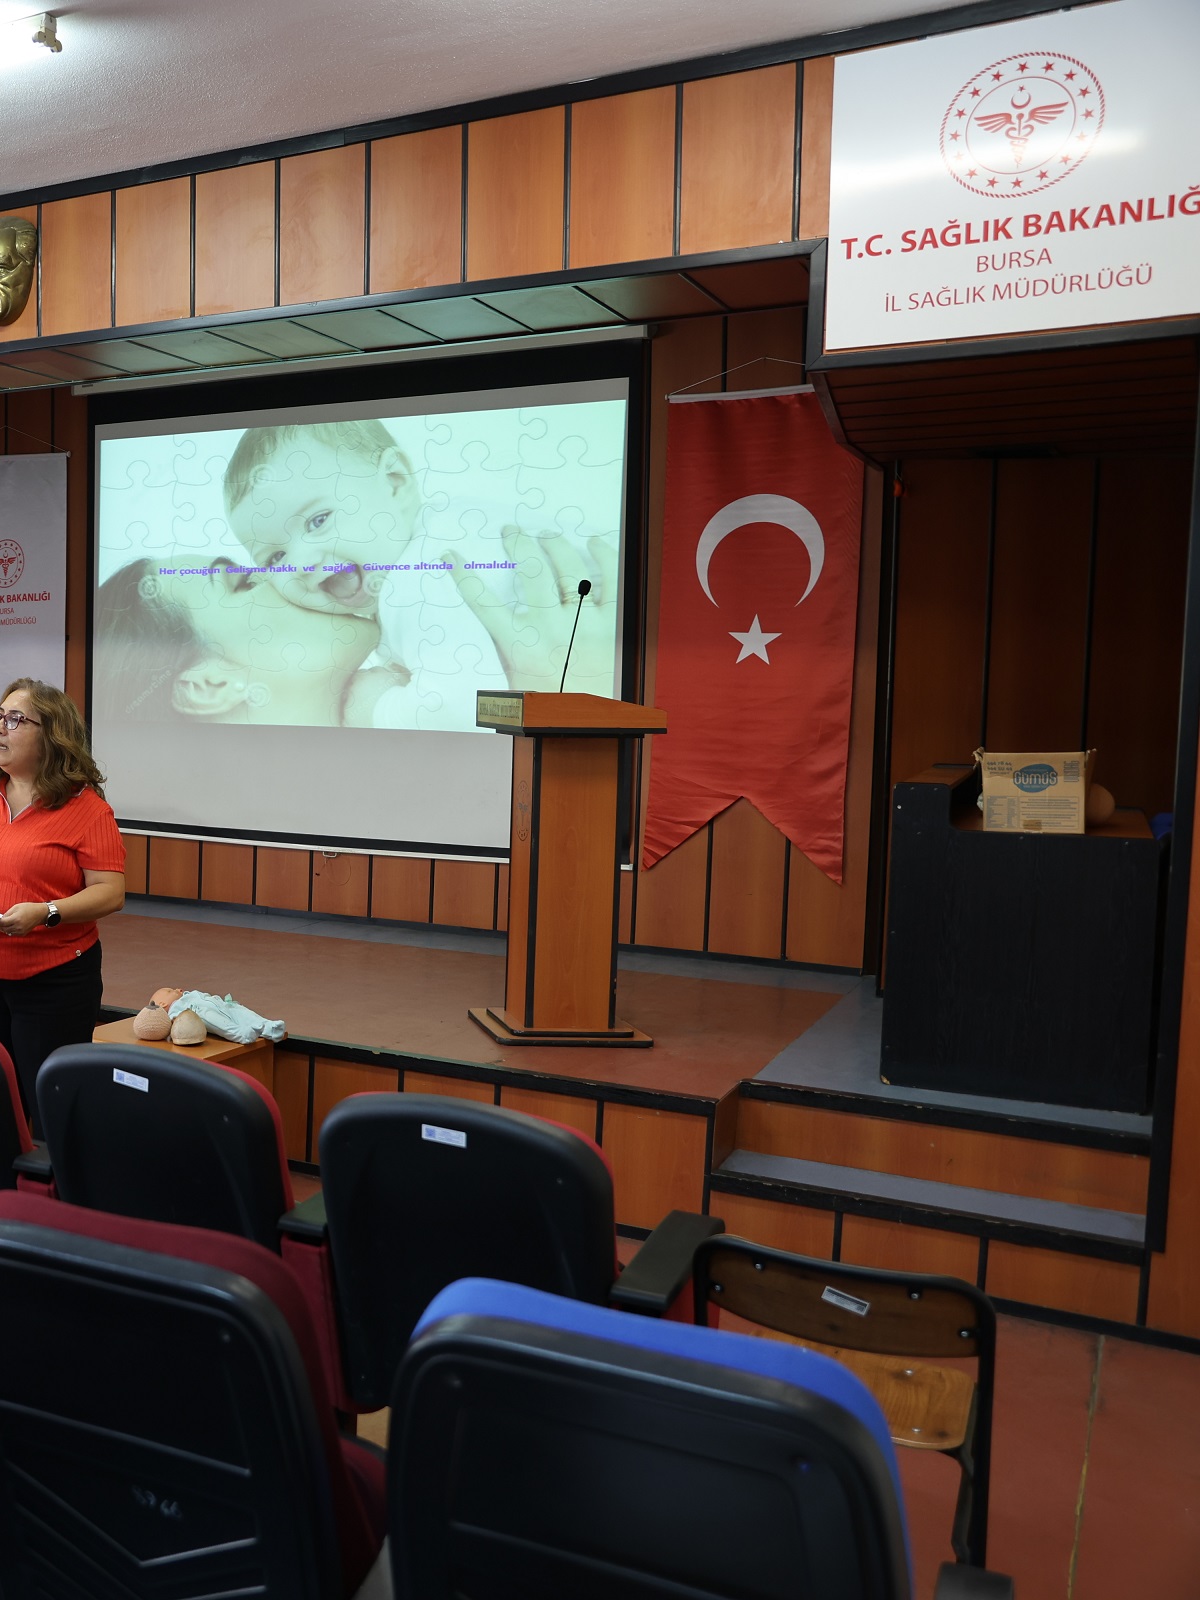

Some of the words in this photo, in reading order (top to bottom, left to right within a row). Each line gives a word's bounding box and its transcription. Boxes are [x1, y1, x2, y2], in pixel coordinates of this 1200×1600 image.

[841, 234, 892, 260] T.C.
[900, 217, 1013, 253] SAĞLIK
[1022, 185, 1200, 238] BAKANLIĞ
[976, 248, 1052, 273] BURSA
[885, 292, 902, 312] İL
[907, 286, 986, 310] SAĞLIK
[991, 262, 1153, 301] MÜDÜRLÜĞÜ
[159, 567, 177, 576] Her
[179, 566, 221, 578] çocuğun
[226, 565, 267, 577] Gelişme
[269, 564, 297, 574] hakkı
[363, 562, 411, 572] Güvence
[414, 561, 453, 571] altında
[464, 560, 517, 571] olmalıdır
[7, 591, 51, 603] BAKANLIĞI
[0, 616, 36, 626] MÜDÜRLÜĞÜ
